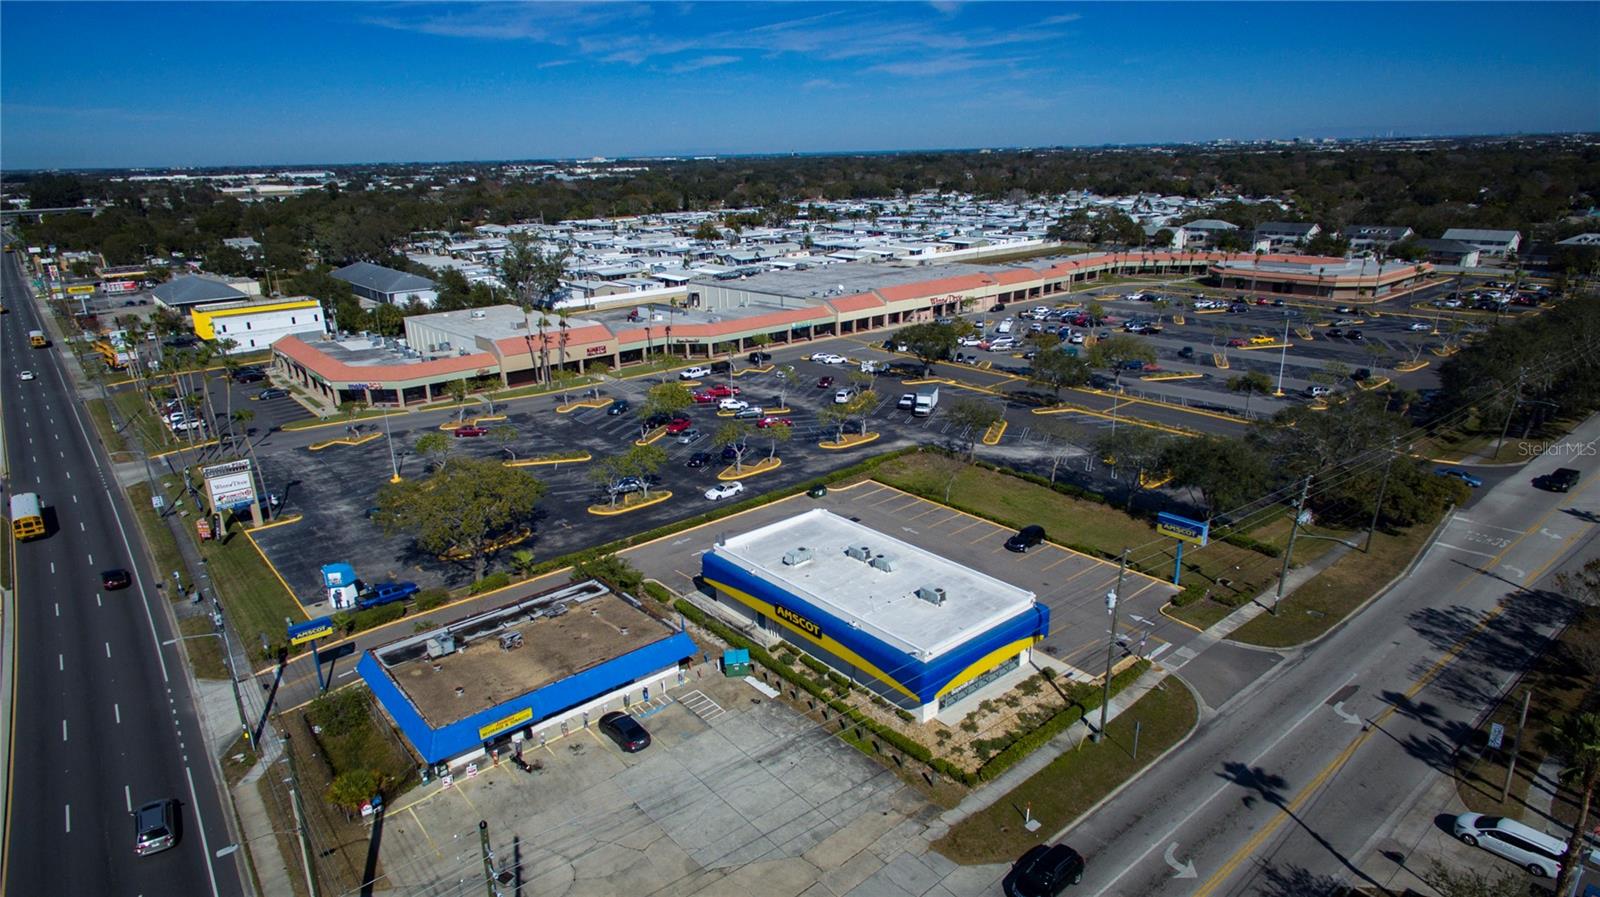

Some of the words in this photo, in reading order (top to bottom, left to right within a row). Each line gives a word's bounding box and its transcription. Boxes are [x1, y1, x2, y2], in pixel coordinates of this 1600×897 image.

[1164, 523, 1196, 537] AMSCOT
[777, 606, 820, 635] AMSCOT
[296, 625, 327, 638] AMSCOT
